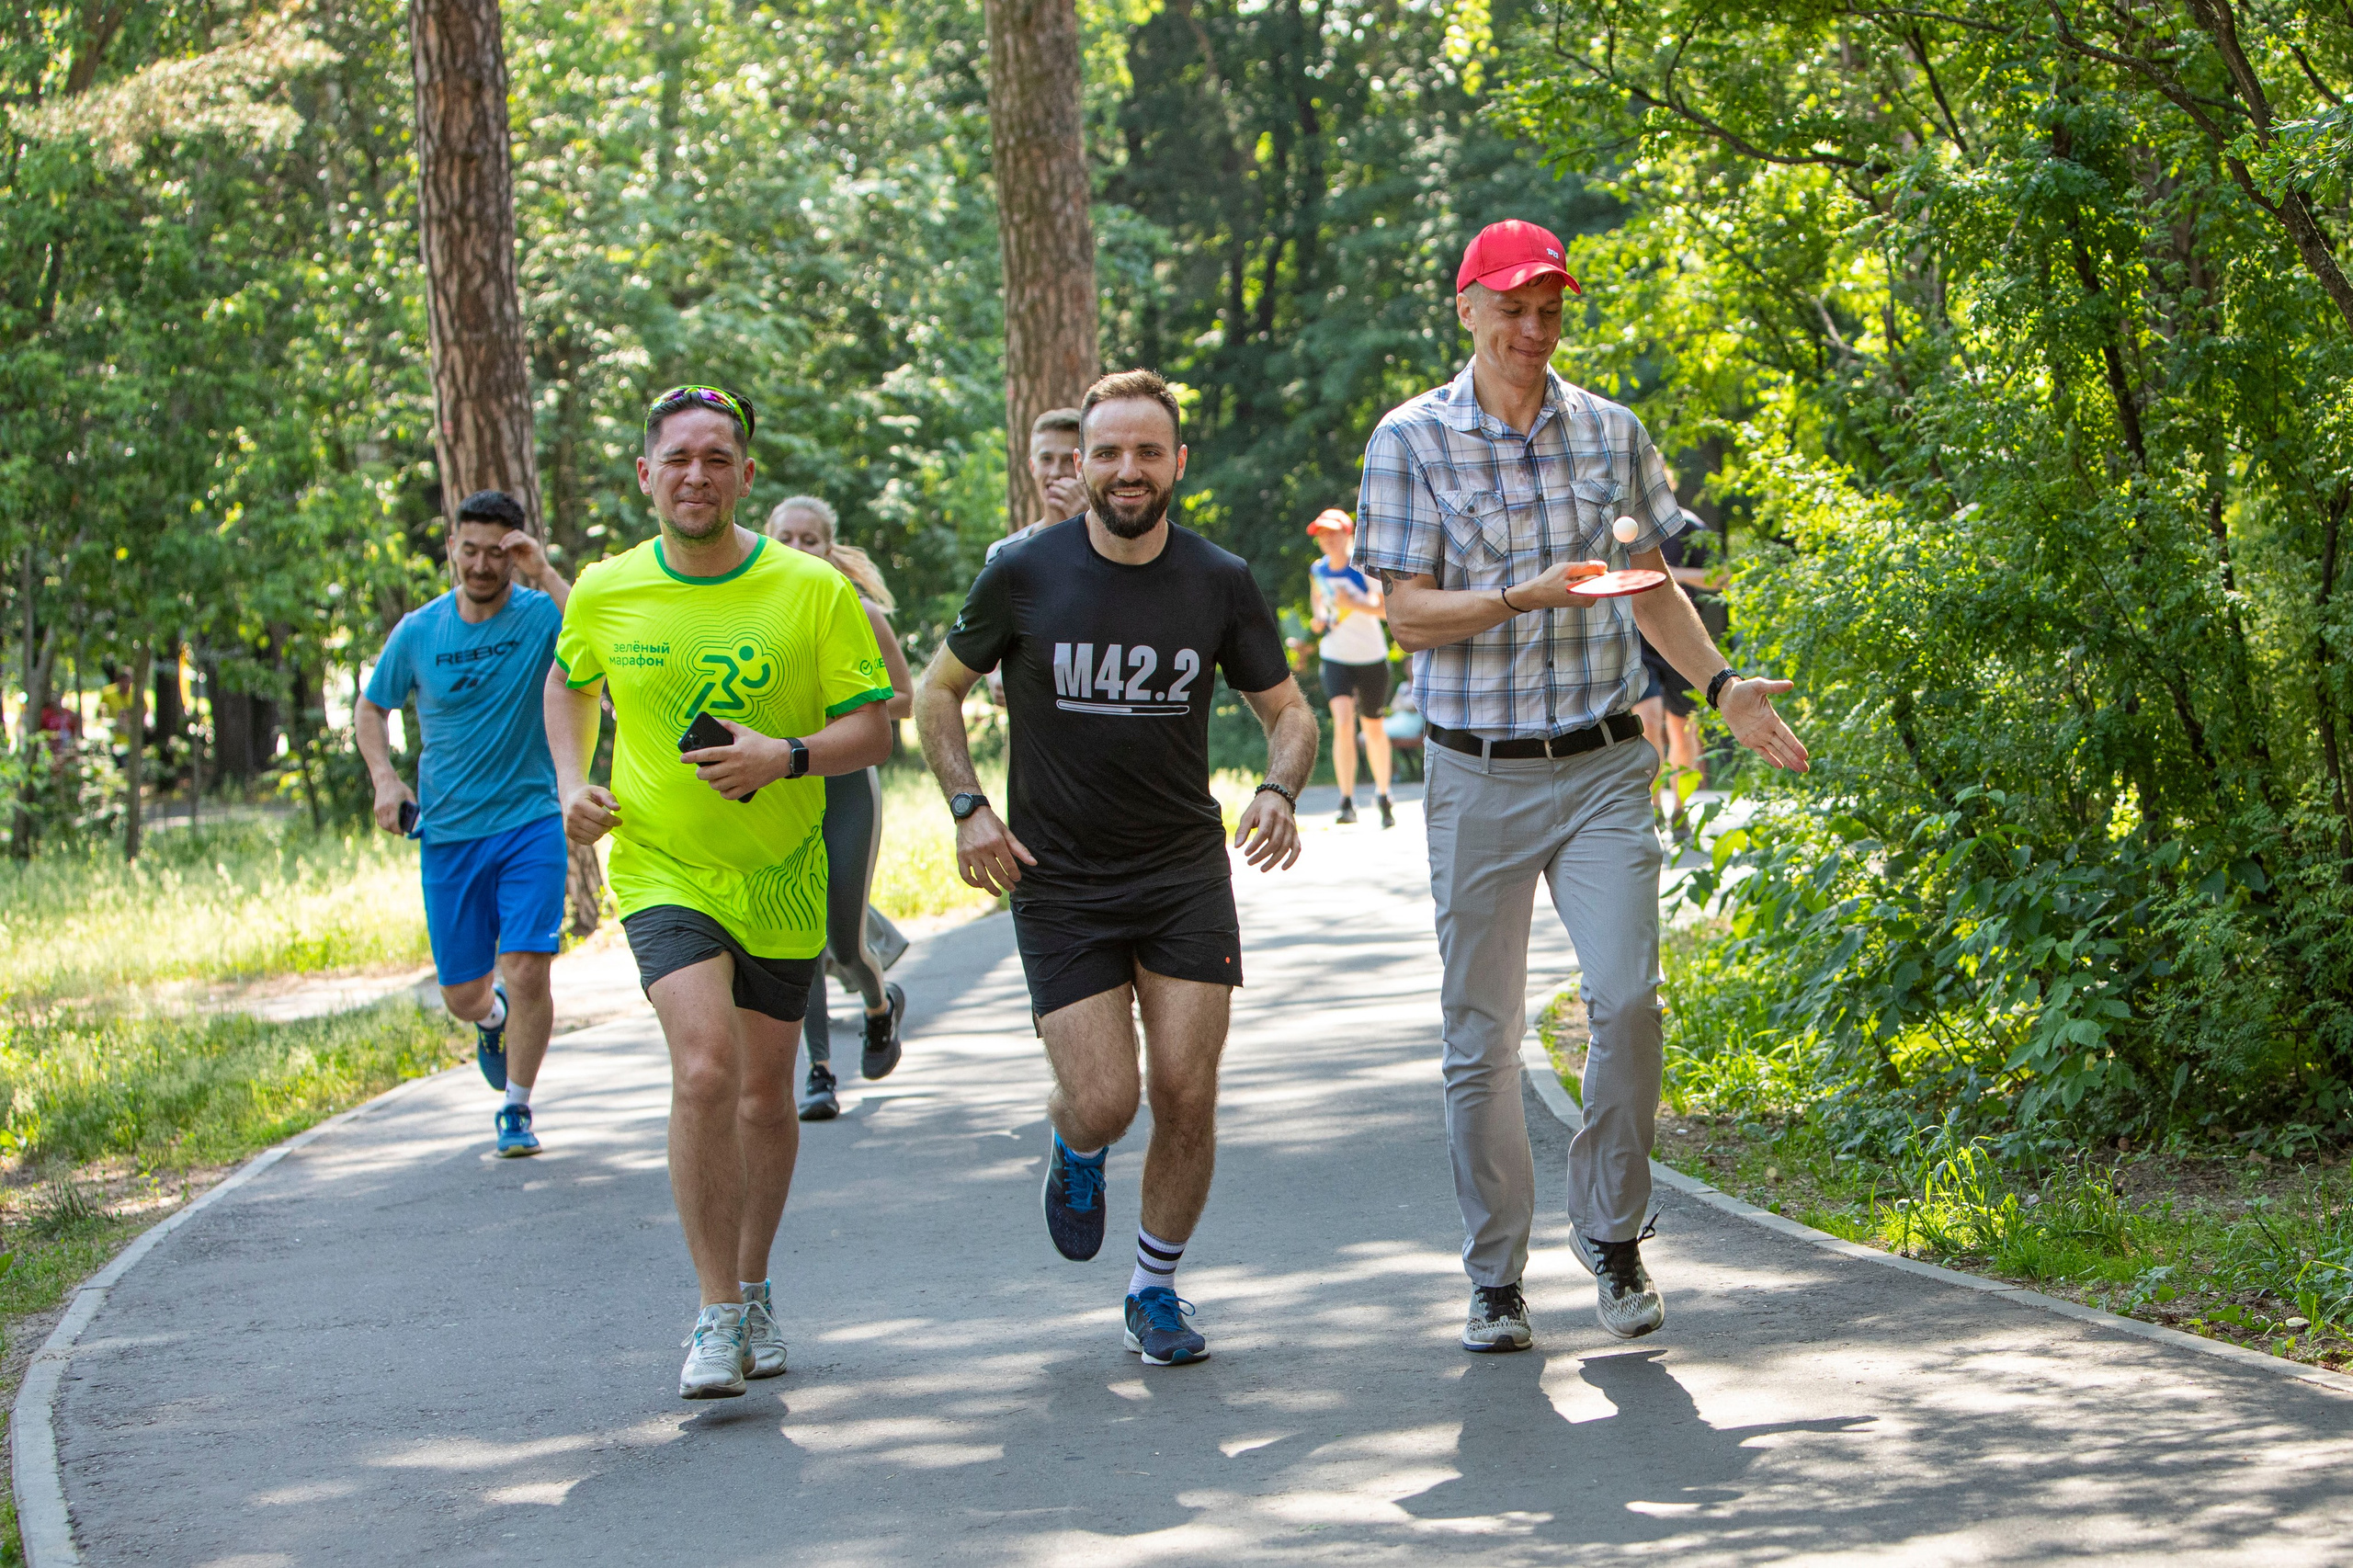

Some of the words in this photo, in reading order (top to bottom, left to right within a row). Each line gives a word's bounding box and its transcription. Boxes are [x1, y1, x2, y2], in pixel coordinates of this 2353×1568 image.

[436, 640, 521, 666] REEBO
[613, 641, 670, 654] зелёный
[608, 653, 665, 668] марафон
[1053, 642, 1200, 701] M42.2
